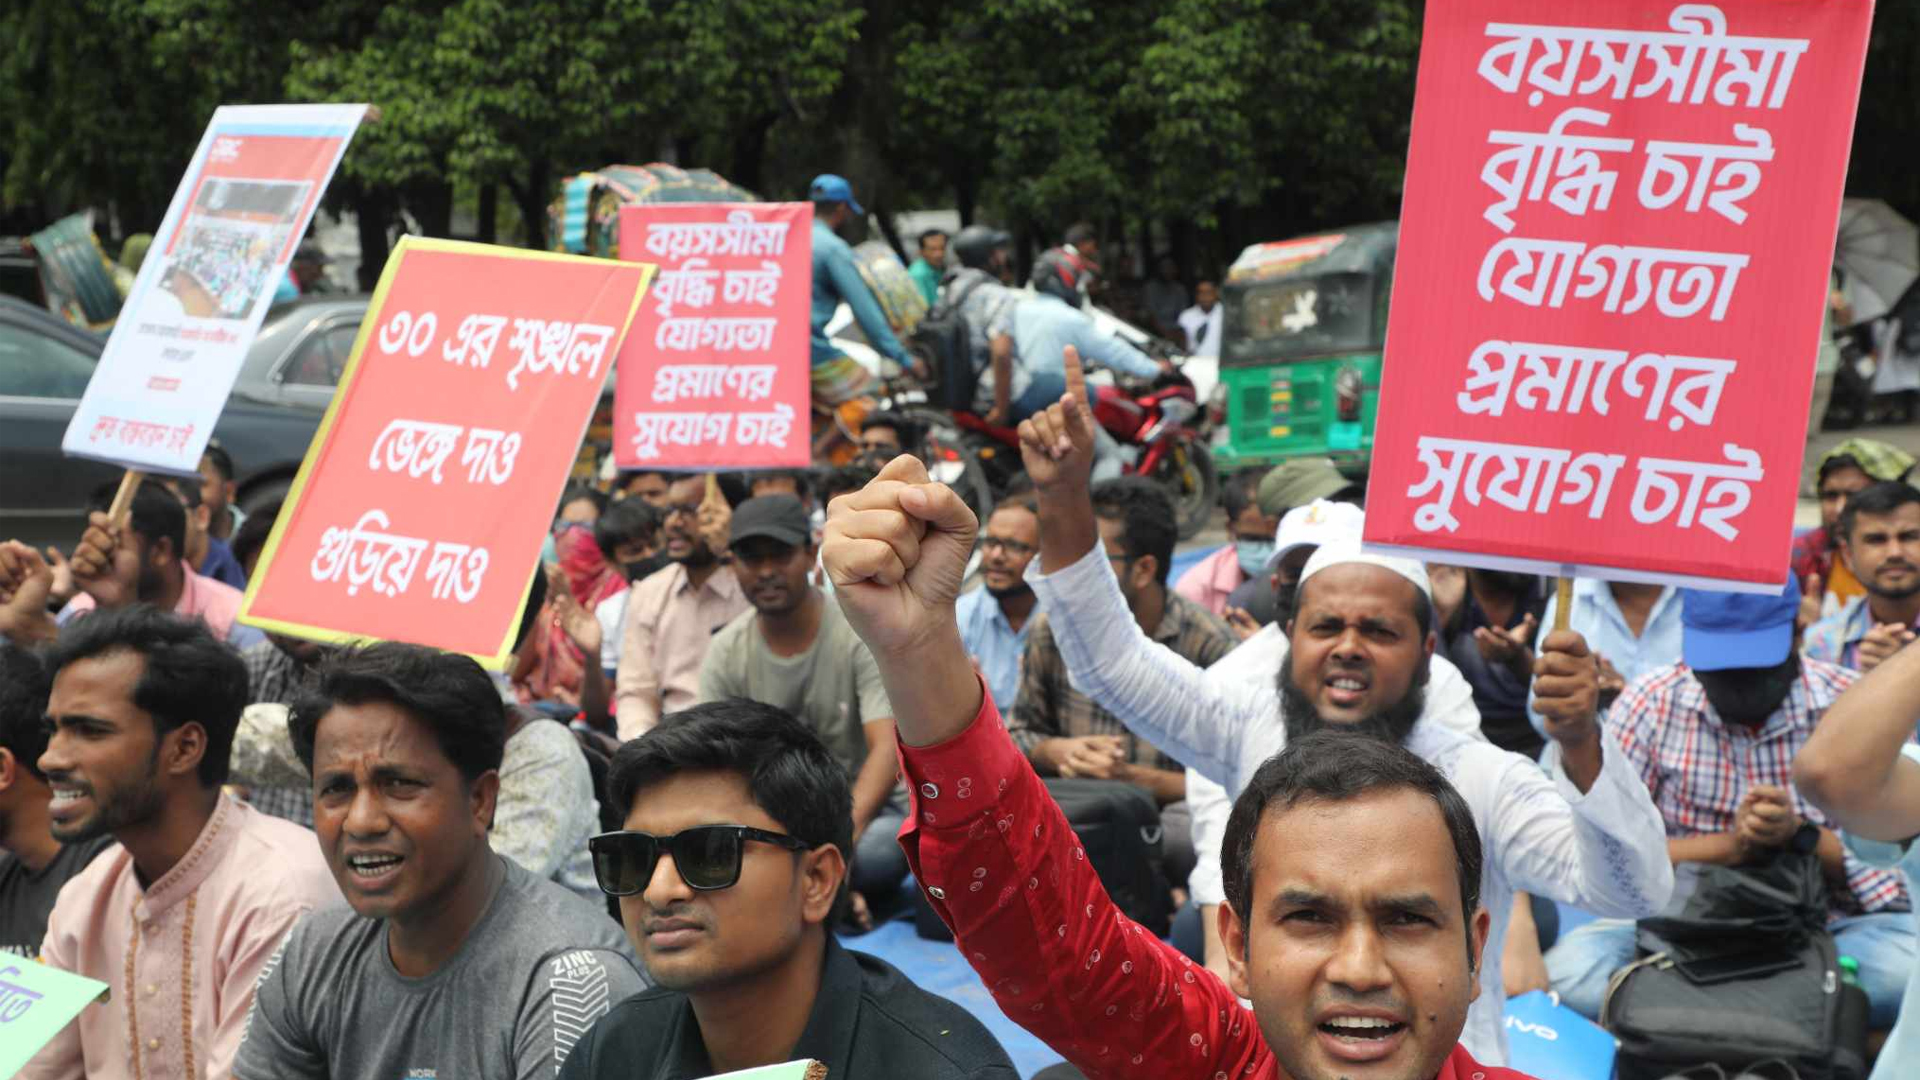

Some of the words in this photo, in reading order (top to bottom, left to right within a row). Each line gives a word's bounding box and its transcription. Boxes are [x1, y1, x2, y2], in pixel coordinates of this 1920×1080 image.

[1478, 4, 1809, 108] বয়সসীমা
[1481, 107, 1634, 233] বৃদ্ধি
[1637, 123, 1775, 225] চাই
[645, 210, 790, 261] বয়সসীমা
[652, 257, 721, 316] বৃদ্ধি
[722, 261, 783, 307] চাই
[1477, 238, 1750, 321] যোগ্যতা
[379, 310, 438, 357] ৩০
[442, 313, 508, 368] এর
[655, 315, 777, 352] যোগ্যতা
[651, 364, 777, 403] প্রমাণের
[1457, 340, 1737, 431] প্রমাণের
[369, 418, 464, 485] ভেঙ্গে
[461, 427, 522, 486] দাও
[632, 411, 733, 460] সুযোগ
[735, 402, 795, 449] চাই
[1407, 436, 1626, 533] সুযোগ
[1631, 443, 1765, 542] চাই
[310, 509, 430, 598] গুড়িয়ে
[425, 541, 490, 604] দাও
[551, 949, 598, 976] ZINC
[566, 965, 591, 980] PLUS
[1504, 1014, 1559, 1042] ivo
